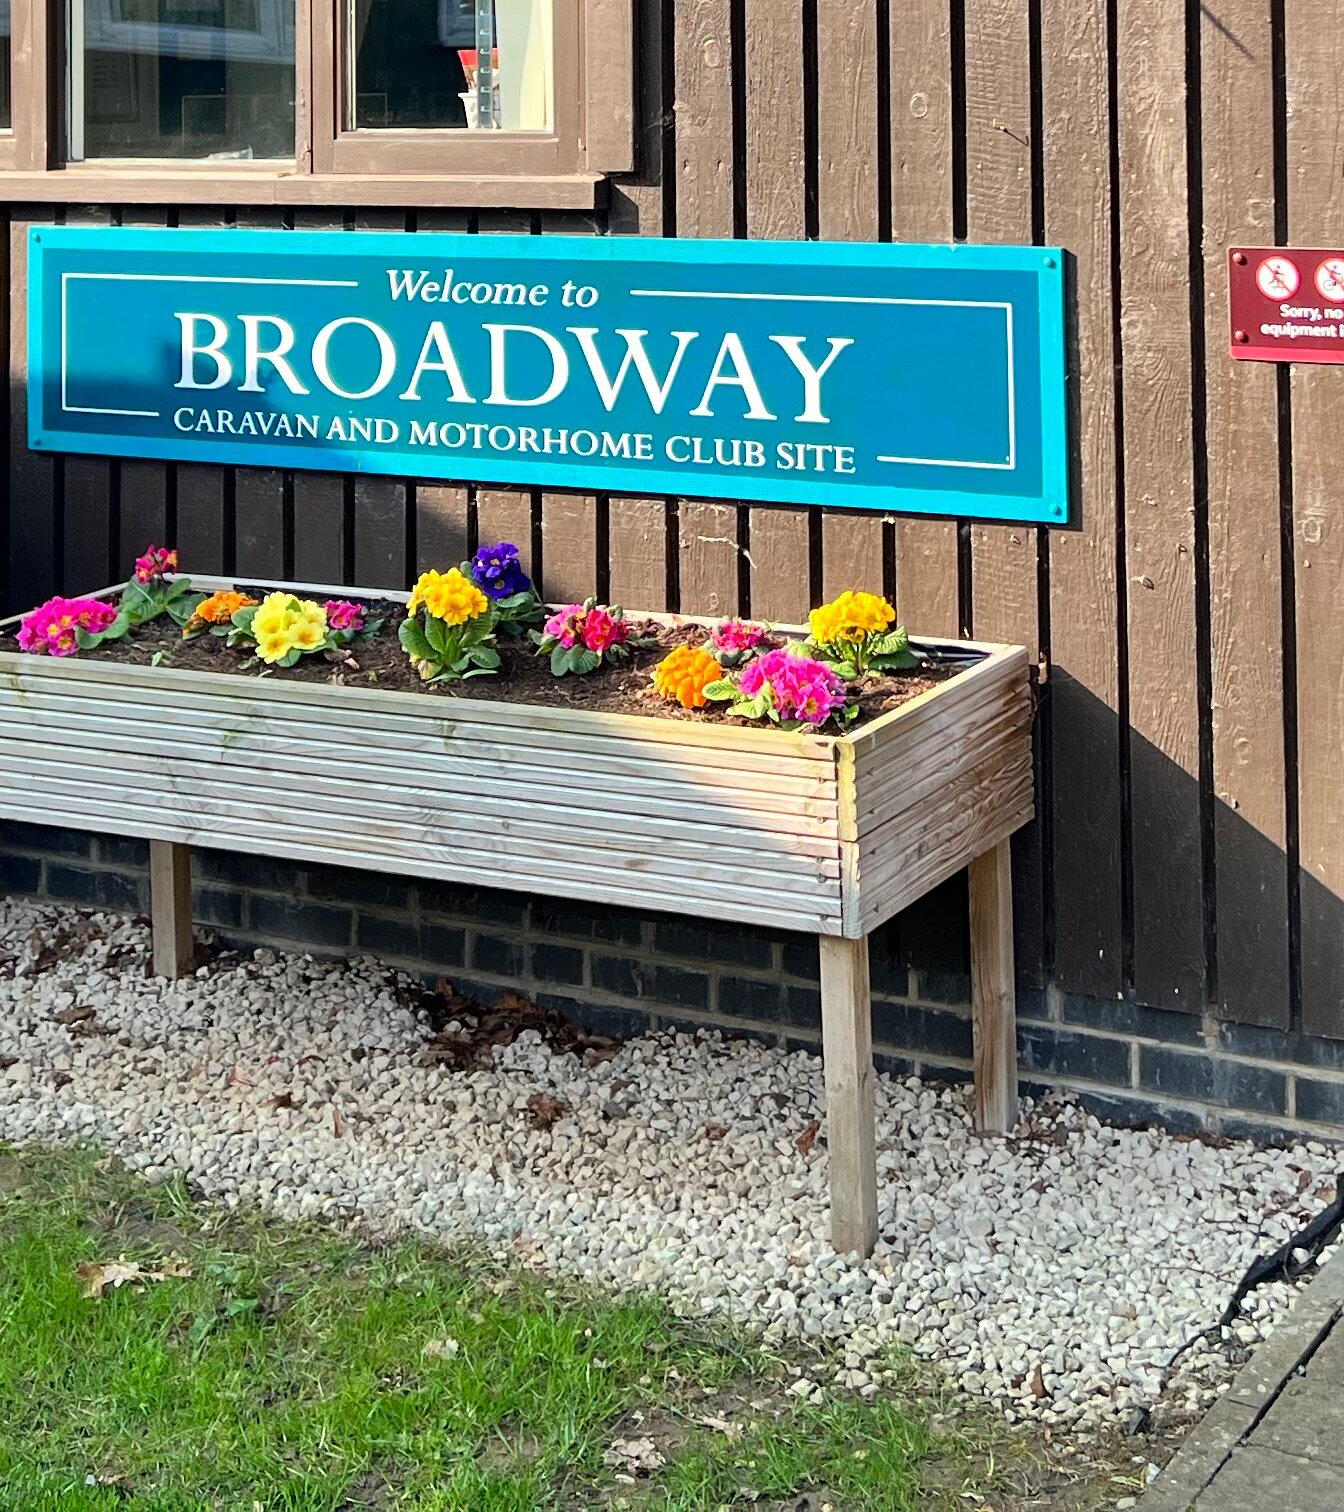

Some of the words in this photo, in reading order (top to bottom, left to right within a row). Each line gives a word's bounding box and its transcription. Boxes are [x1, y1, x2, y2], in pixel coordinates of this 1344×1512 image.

[386, 268, 549, 307] Welcome
[560, 279, 600, 309] to
[1260, 321, 1338, 339] equipment
[1279, 303, 1323, 322] Sorry,
[1323, 307, 1344, 320] no
[173, 311, 855, 424] BROADWAY
[173, 407, 319, 439] CARAVAN
[325, 415, 400, 444] AND
[408, 420, 654, 462] MOTORHOME
[665, 435, 767, 468] CLUB
[775, 443, 856, 474] SITE
